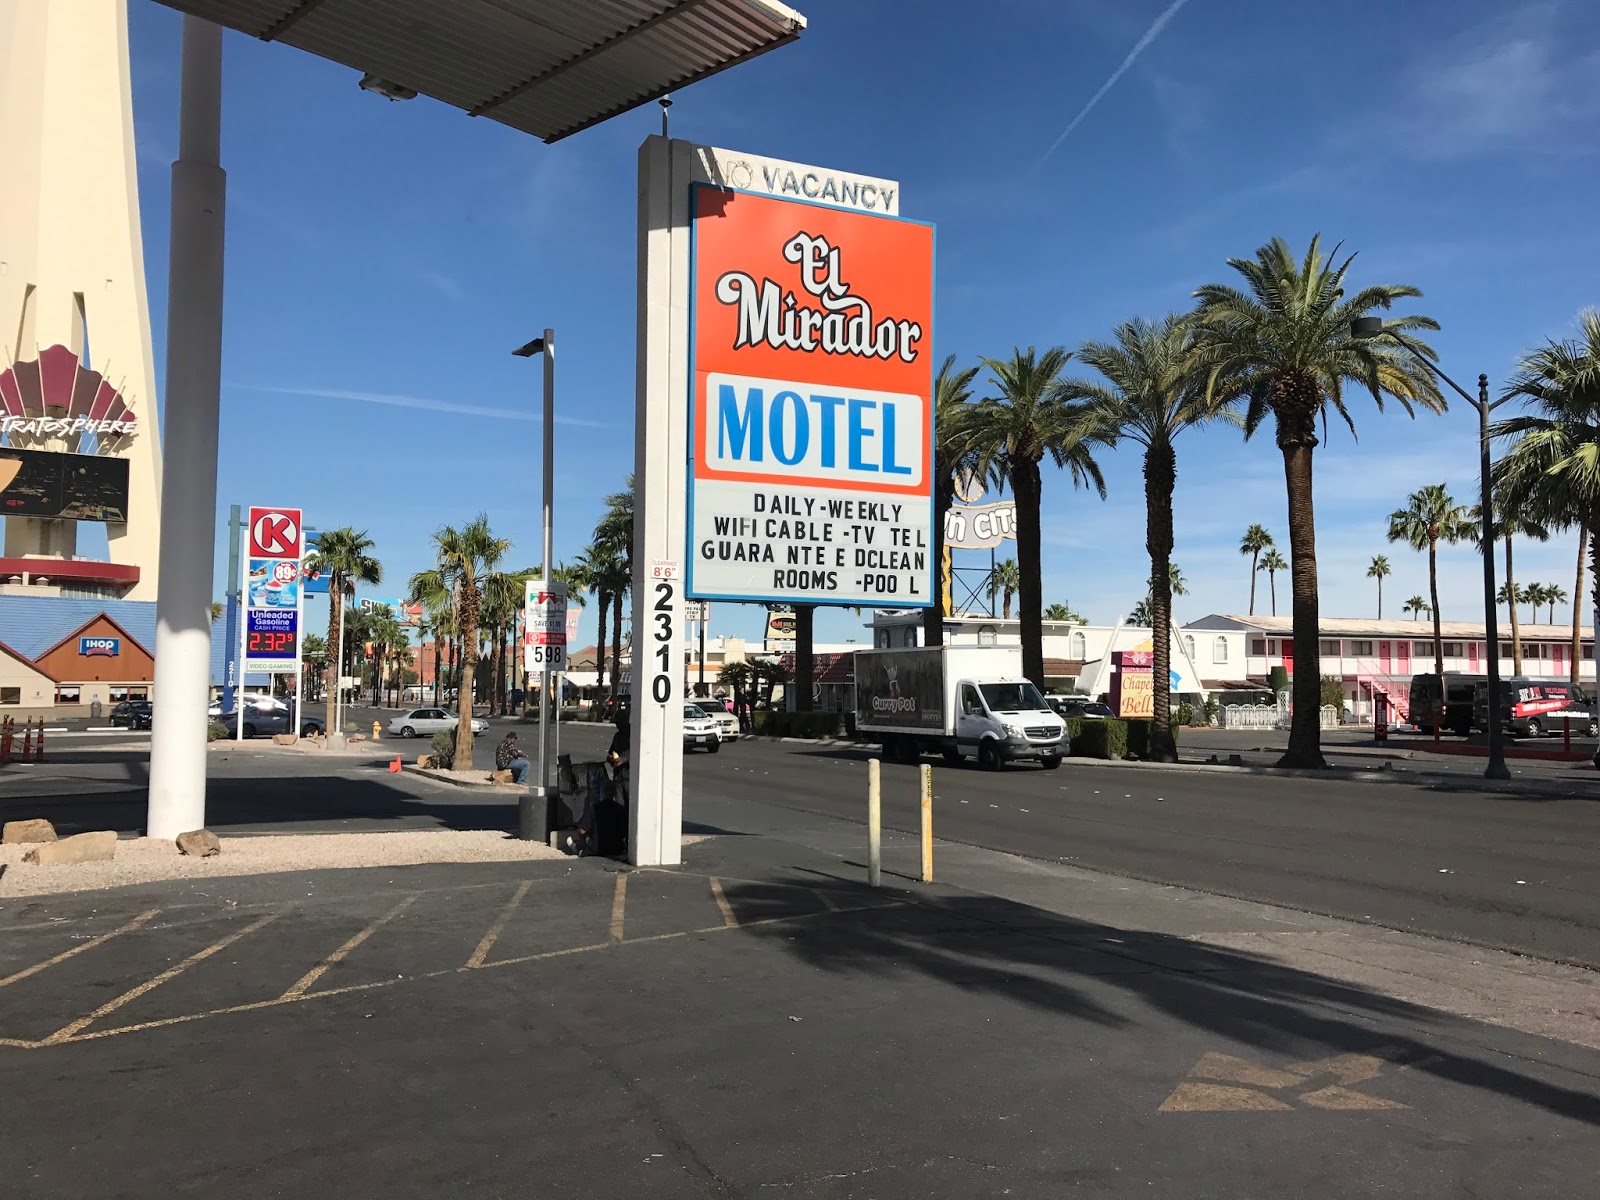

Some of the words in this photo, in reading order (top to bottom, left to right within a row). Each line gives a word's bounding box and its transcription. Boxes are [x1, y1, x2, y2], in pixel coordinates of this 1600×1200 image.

[762, 165, 896, 212] VACANCY
[782, 230, 850, 297] El
[715, 270, 923, 364] Mirador
[0, 410, 138, 438] TRATOSPHERE
[718, 384, 912, 475] MOTEL
[714, 516, 757, 538] WIFI
[891, 528, 926, 548] TEL
[773, 569, 838, 591] ROOMS
[252, 610, 294, 619] Unleaded
[86, 639, 115, 651] IHOP
[652, 583, 674, 703] 2310
